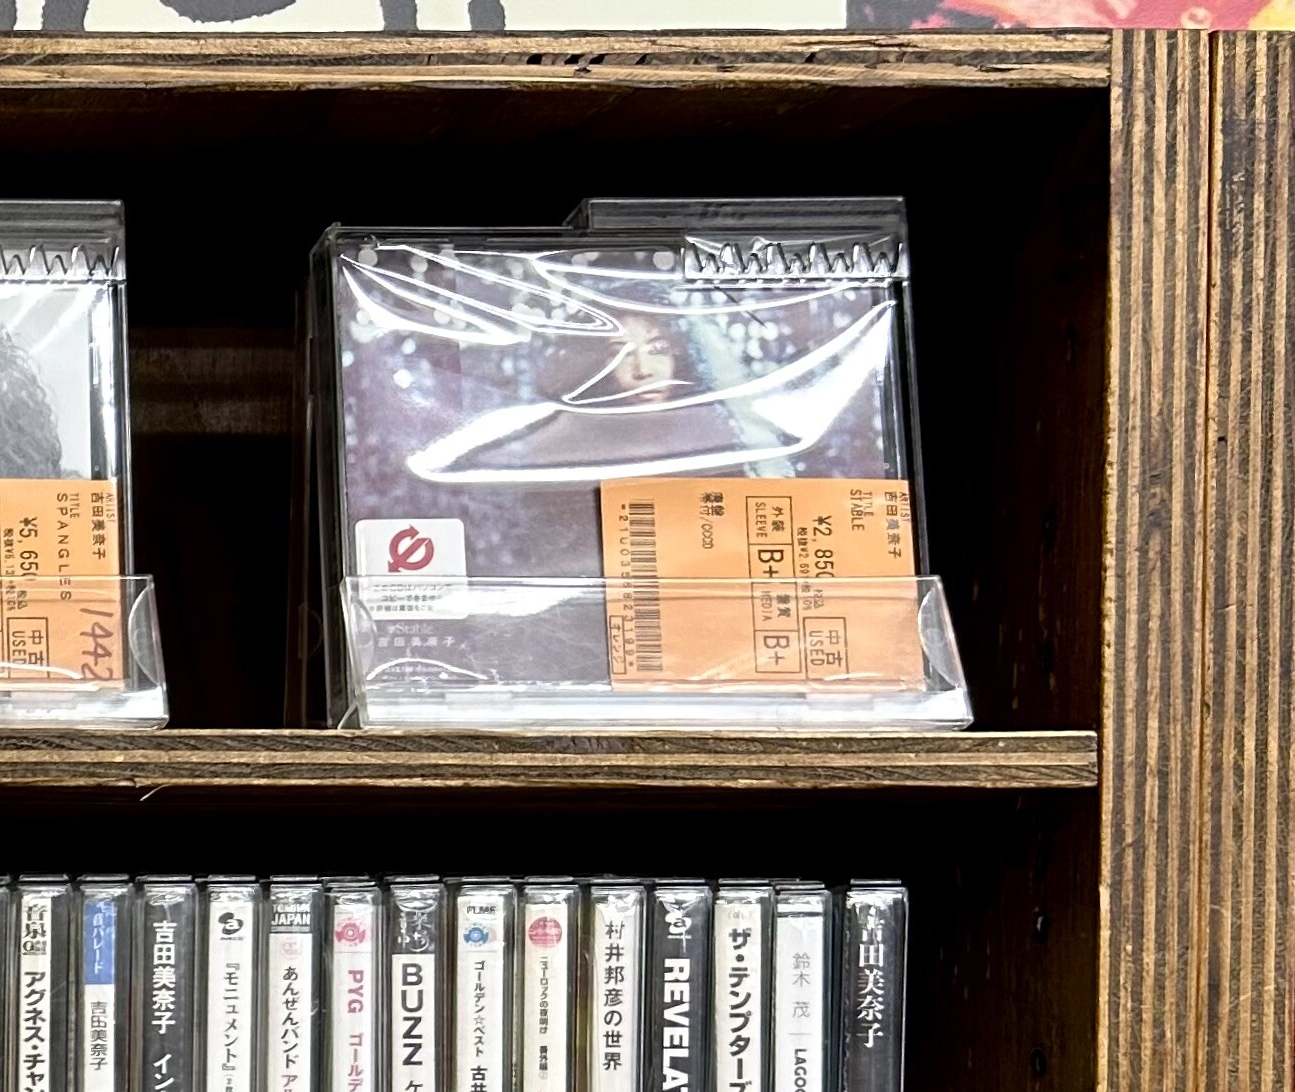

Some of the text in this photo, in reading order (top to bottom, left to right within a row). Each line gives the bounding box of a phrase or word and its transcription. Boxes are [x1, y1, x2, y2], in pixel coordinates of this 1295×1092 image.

[754, 501, 768, 538] SLEEVE
[57, 492, 72, 601] SPANGLES
[27, 629, 45, 667] 中古
[763, 635, 790, 667] B+
[809, 630, 825, 667] USED
[826, 629, 841, 668] 中古
[152, 921, 177, 1035] 吉田美奈子
[348, 969, 363, 1014] PYG
[603, 921, 624, 1072] 村井邦彦の世界
[401, 963, 423, 1067] BUZZ
